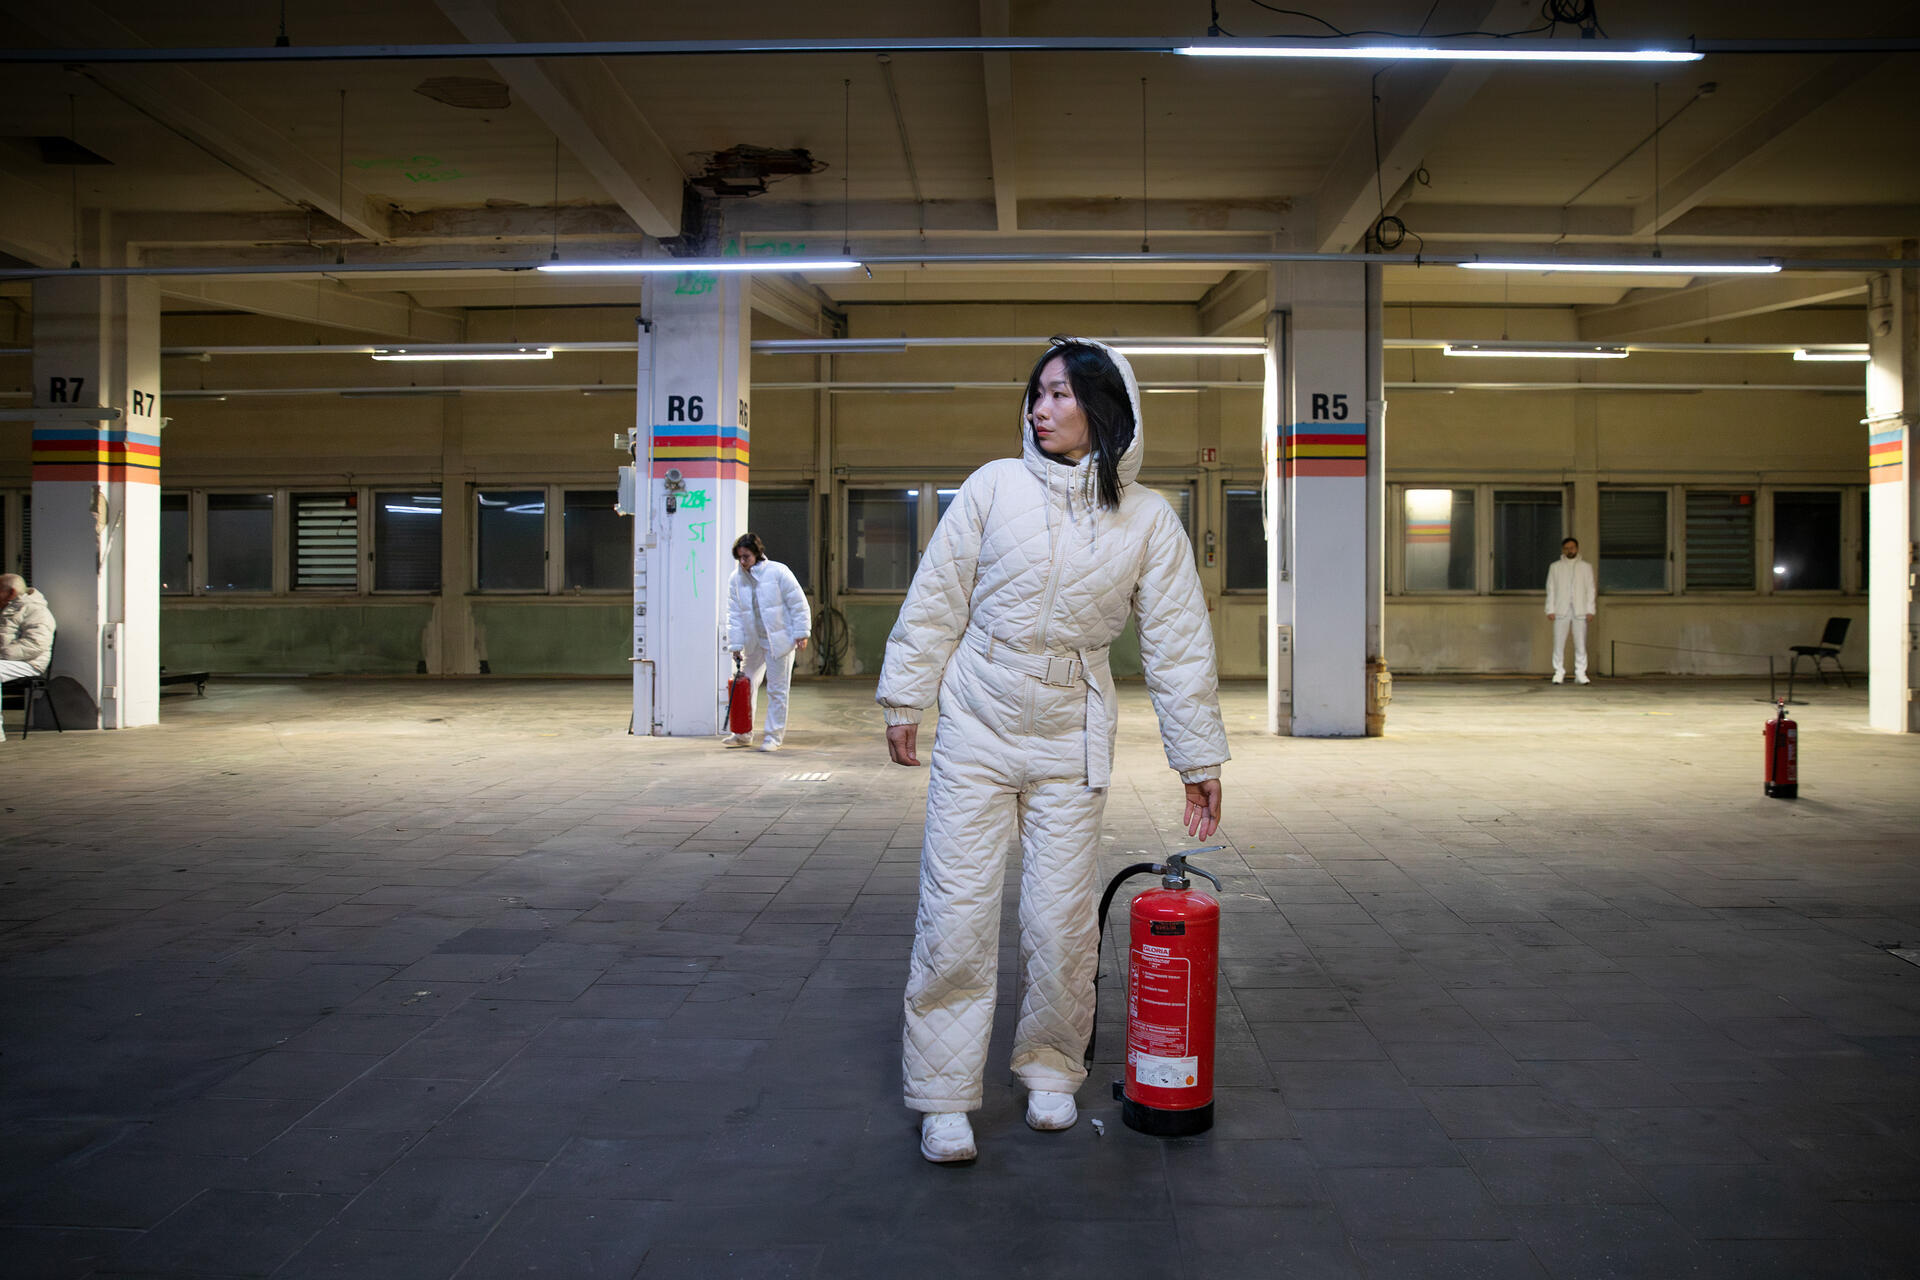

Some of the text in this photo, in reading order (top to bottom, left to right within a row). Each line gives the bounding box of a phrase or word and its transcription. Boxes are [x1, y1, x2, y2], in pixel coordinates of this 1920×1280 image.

[50, 377, 84, 403] R7
[133, 389, 155, 418] R7
[668, 395, 704, 422] R6
[739, 399, 749, 428] R6
[1312, 393, 1348, 420] R5
[1143, 945, 1169, 955] GLORIA
